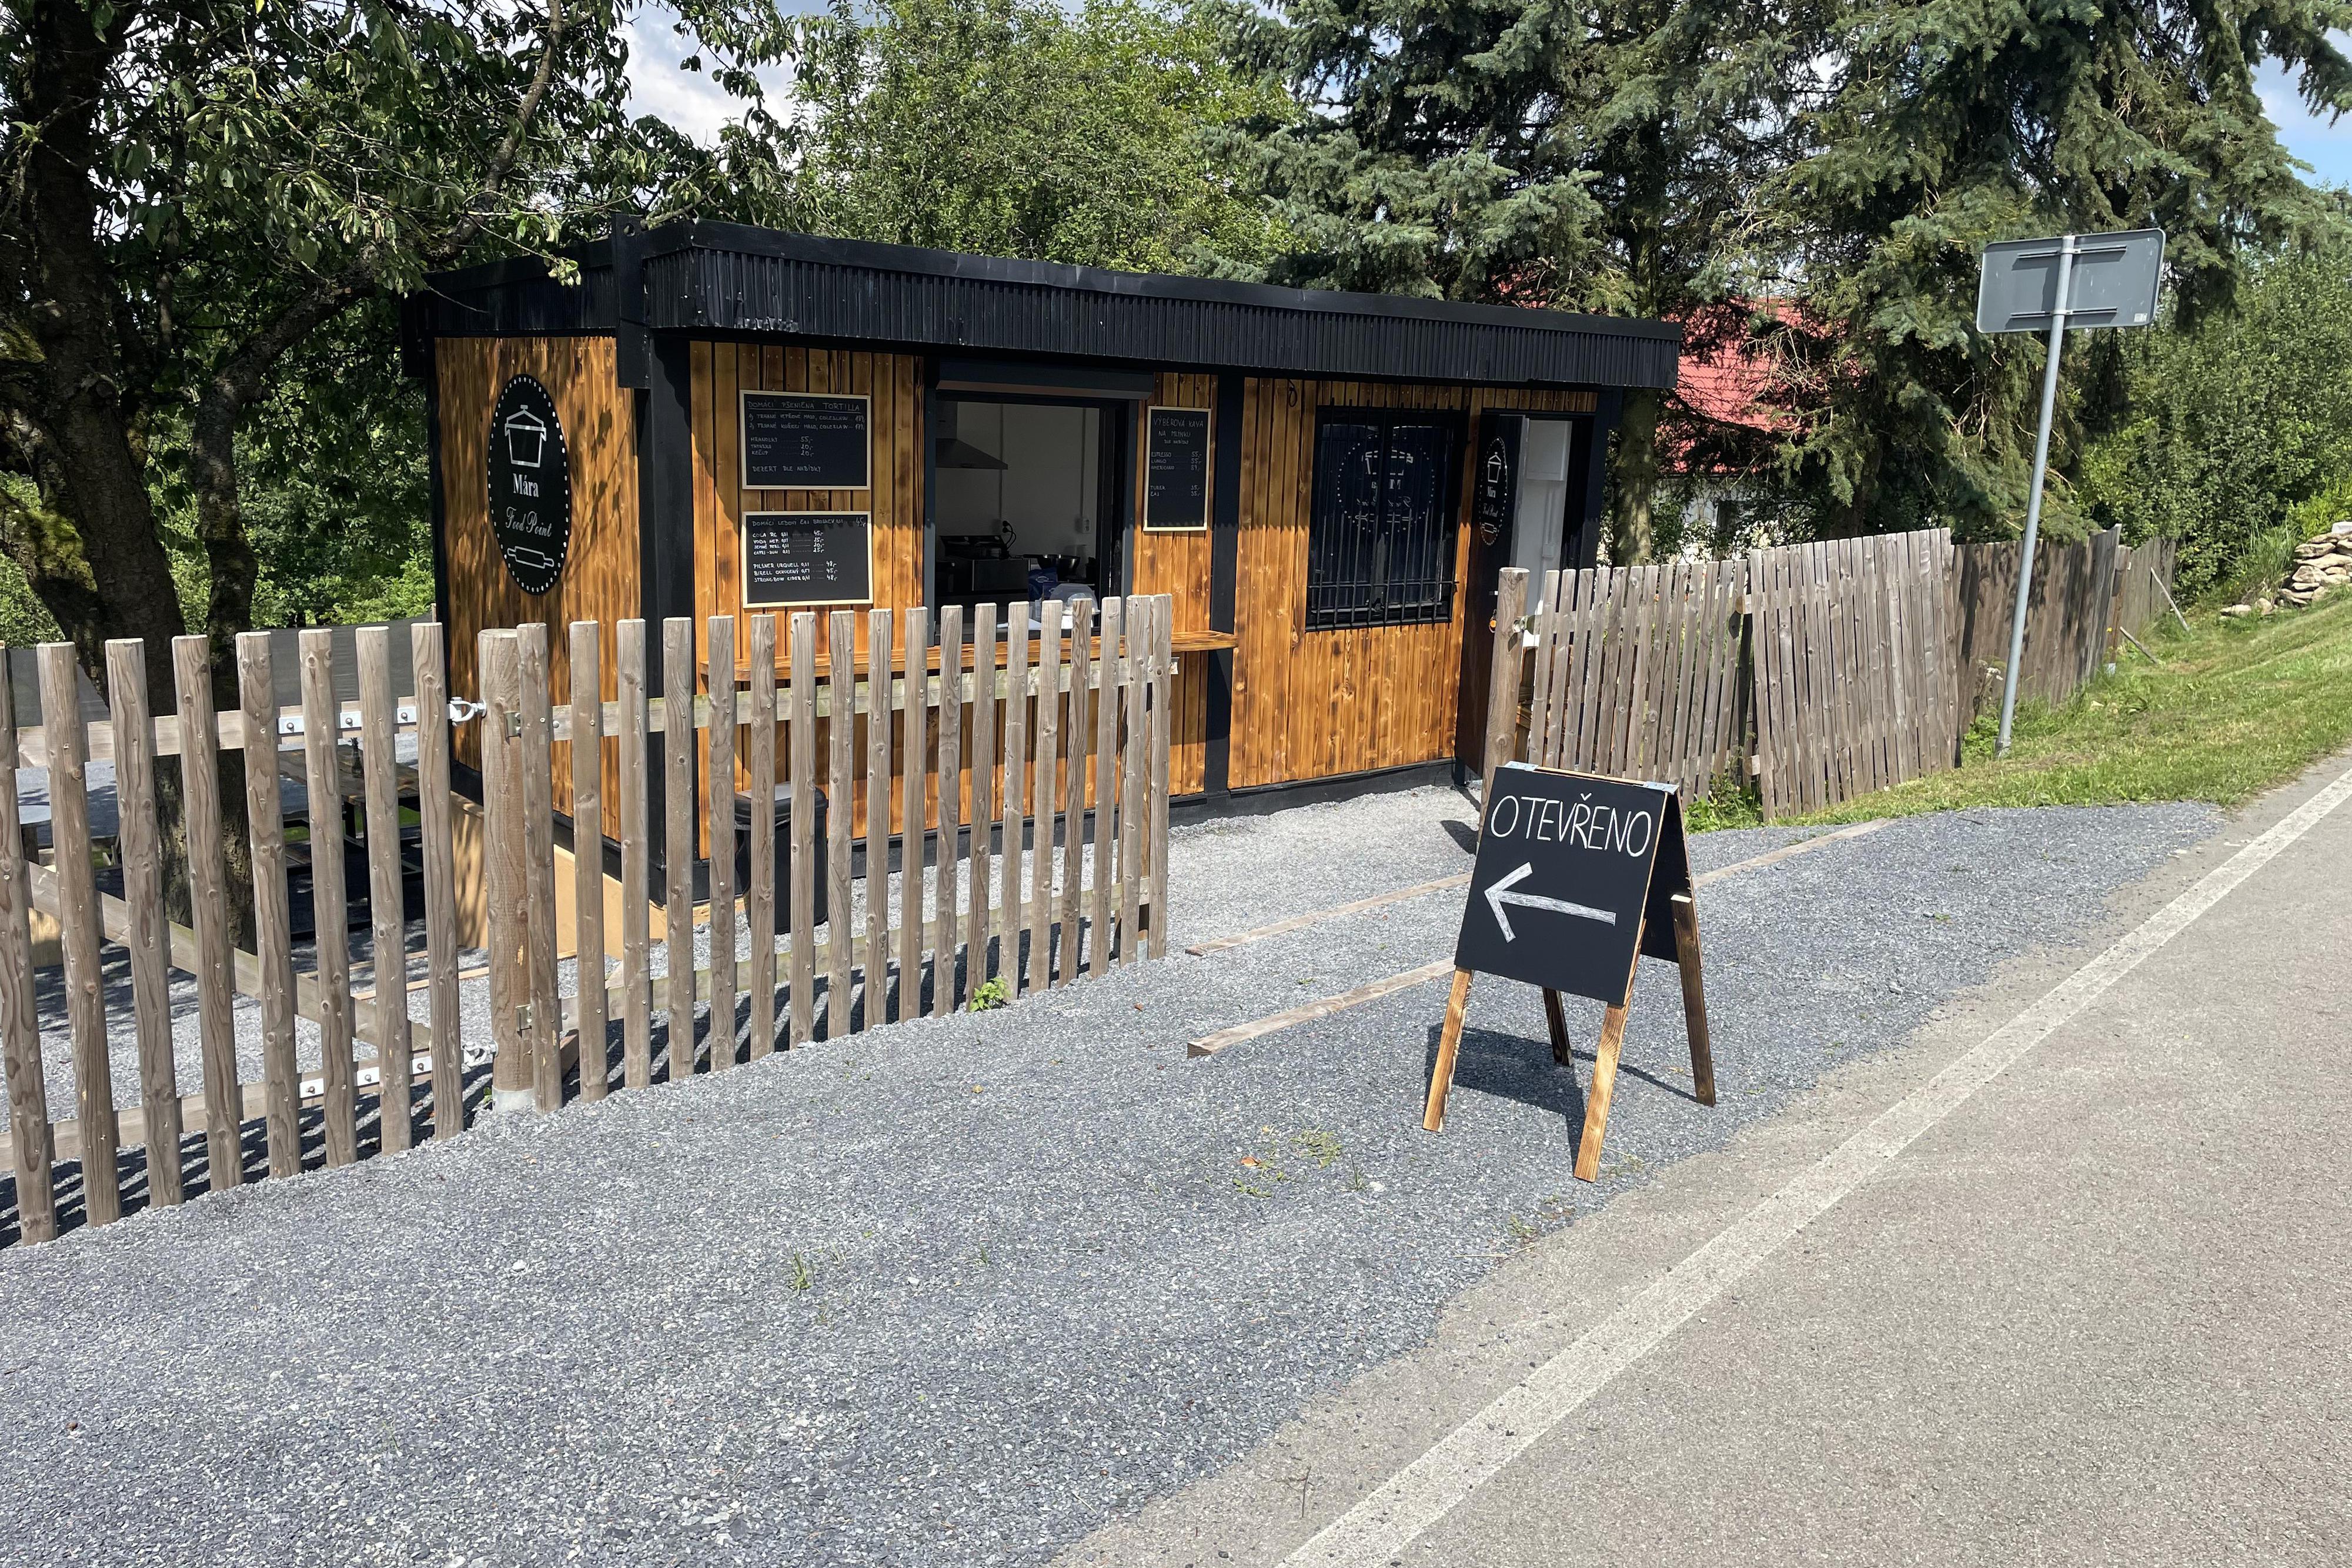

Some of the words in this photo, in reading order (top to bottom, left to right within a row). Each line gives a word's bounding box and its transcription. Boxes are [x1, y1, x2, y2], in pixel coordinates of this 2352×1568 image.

[822, 402, 860, 411] TORTILLA
[797, 464, 821, 473] NABÍDKY
[512, 473, 539, 498] Mára
[505, 506, 527, 531] Food
[526, 511, 552, 537] Point
[1490, 793, 1652, 857] OTEVŘENO
